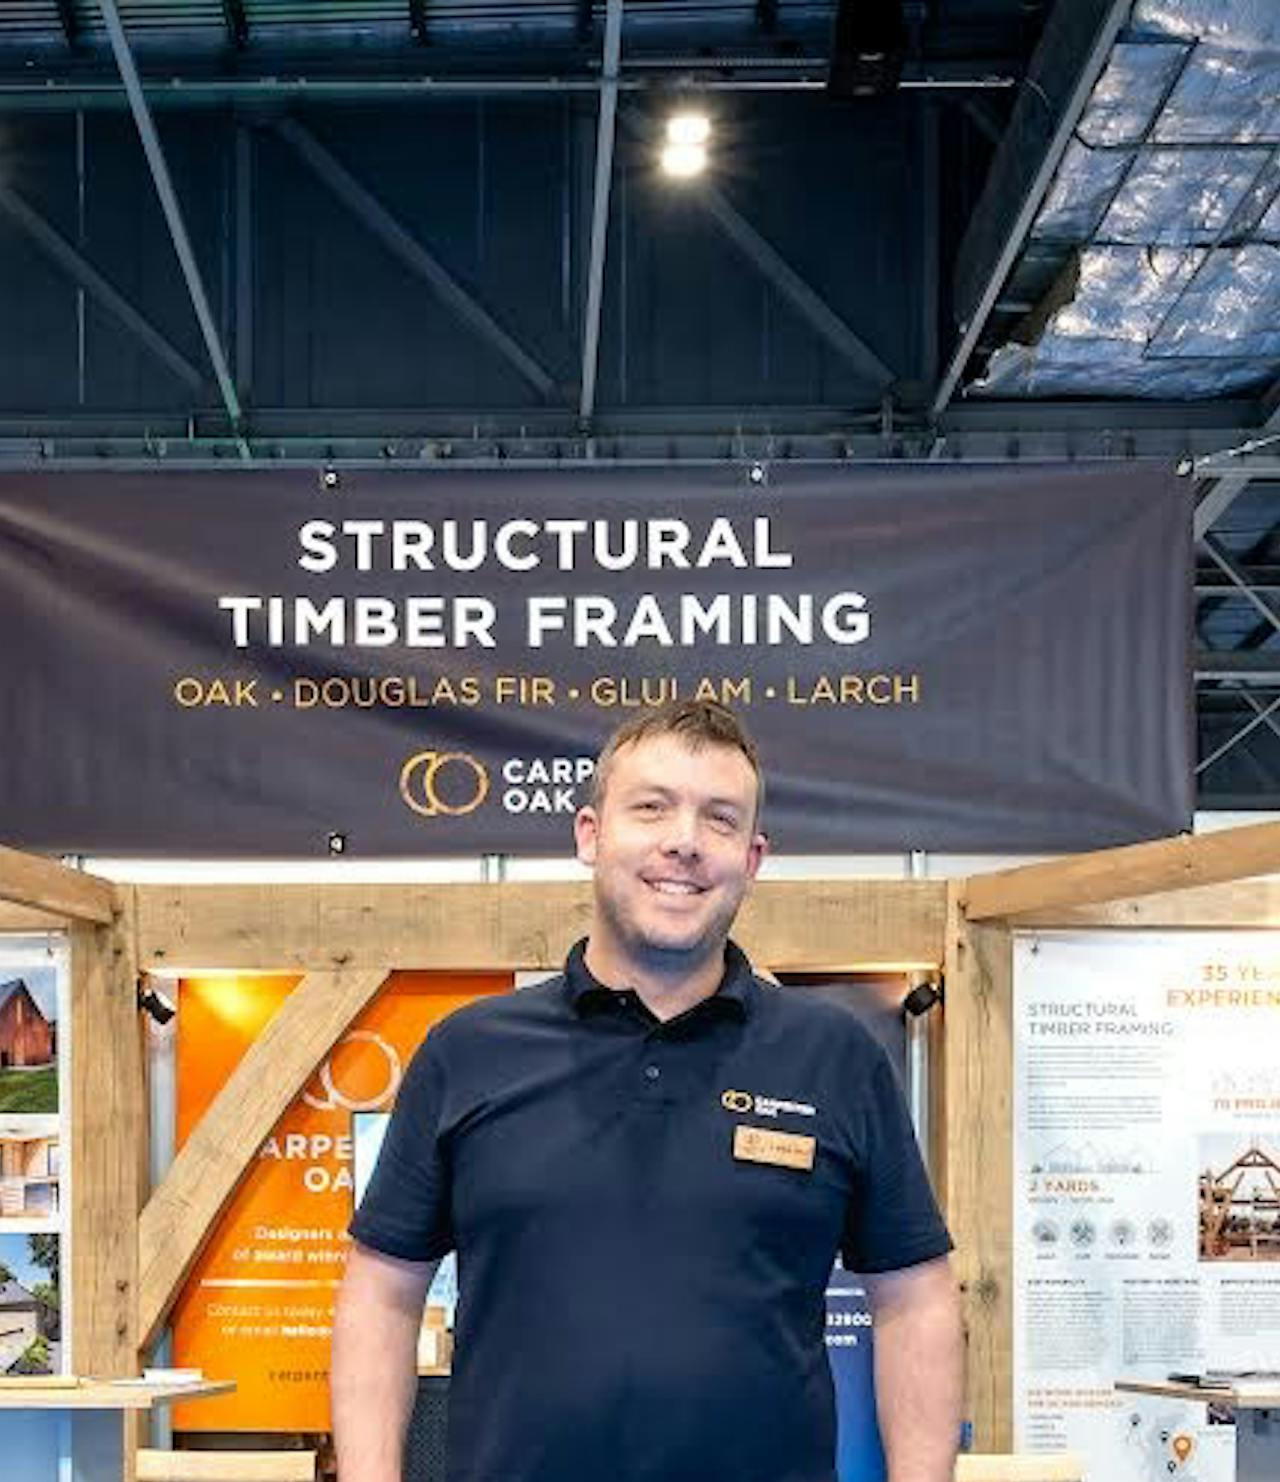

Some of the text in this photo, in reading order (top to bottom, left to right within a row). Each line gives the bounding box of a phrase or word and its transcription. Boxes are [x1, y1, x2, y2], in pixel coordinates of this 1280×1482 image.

[297, 517, 794, 573] STRUCTURAL
[218, 591, 873, 648] TIMBER FRAMING
[174, 677, 259, 708] OAK
[292, 677, 482, 709] DOUGLAS
[494, 675, 556, 707] FIR
[787, 674, 921, 706] LARCH
[503, 757, 595, 785] CARP
[503, 787, 576, 814] OAK
[1201, 964, 1228, 982] 35
[1027, 1002, 1138, 1018] STRUCTURAL
[1028, 1020, 1175, 1036] TIMBER FRAMING
[260, 1133, 353, 1160] ARPE
[304, 1166, 353, 1193] OA
[1044, 1178, 1100, 1194] YARDS
